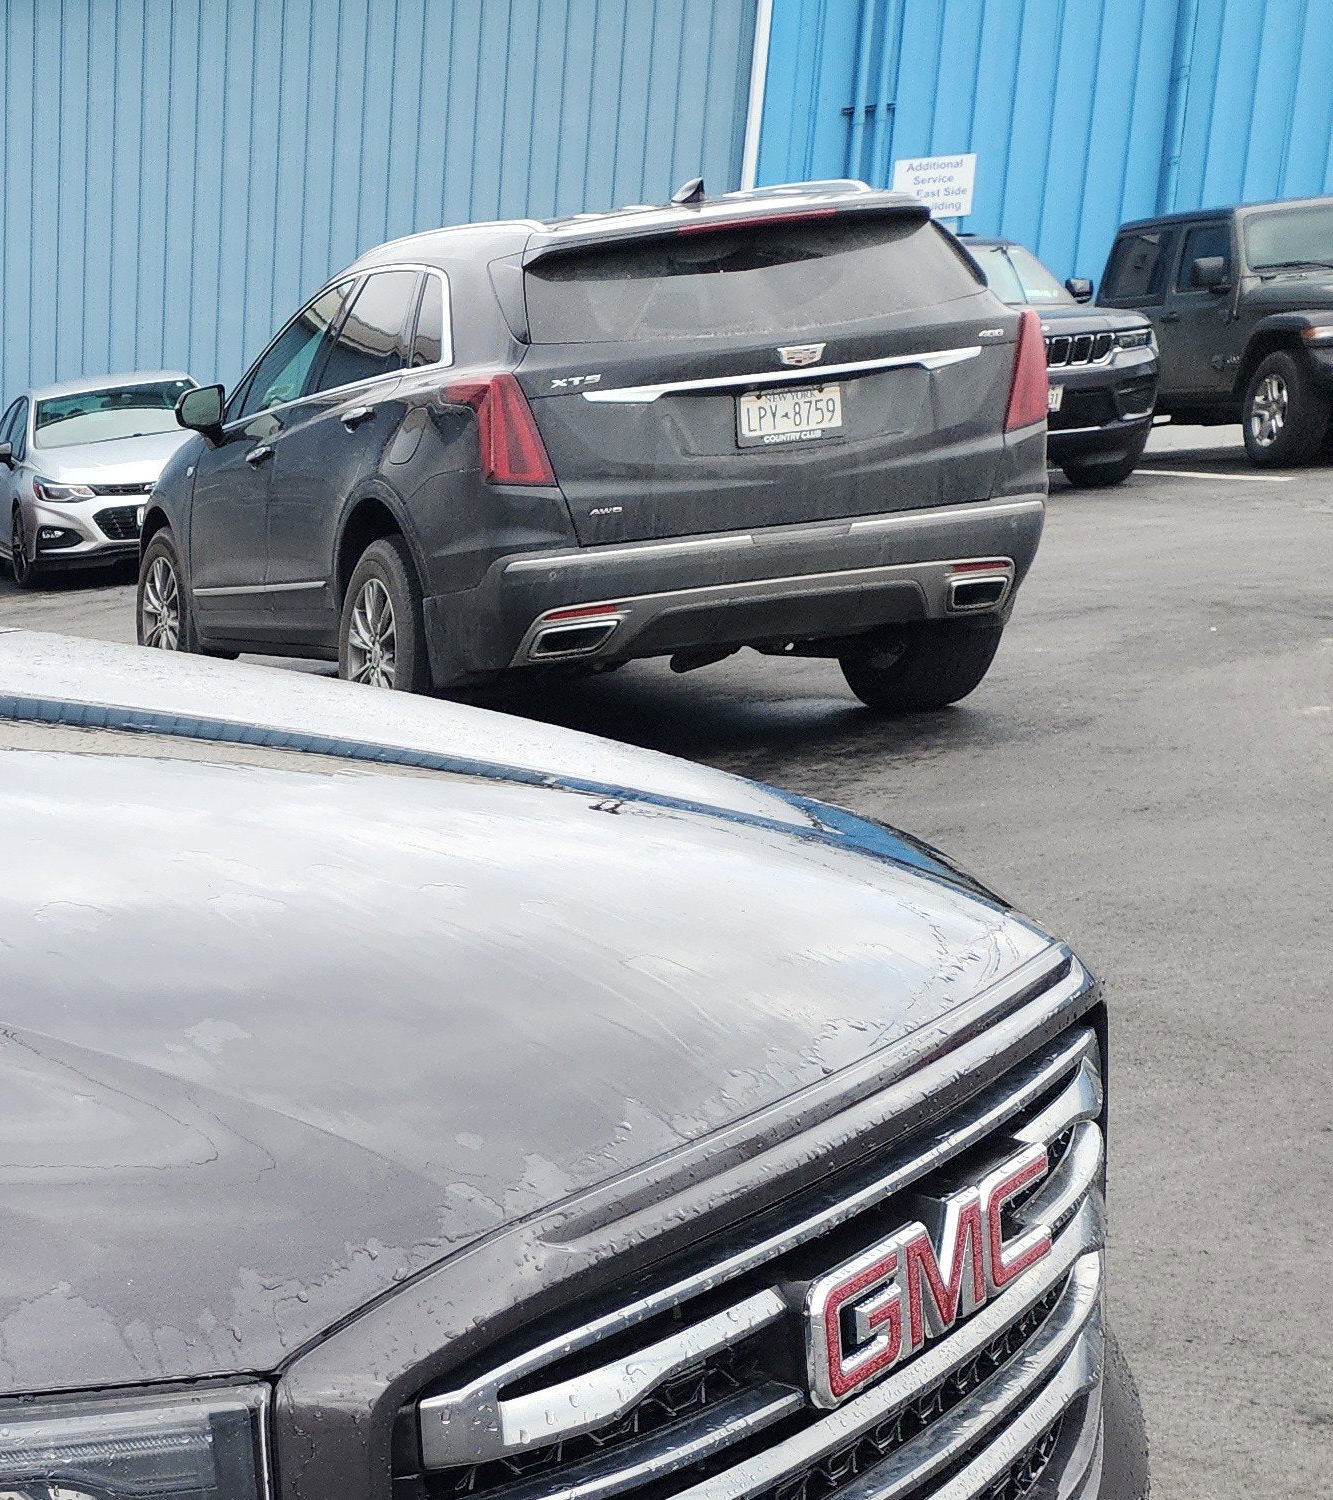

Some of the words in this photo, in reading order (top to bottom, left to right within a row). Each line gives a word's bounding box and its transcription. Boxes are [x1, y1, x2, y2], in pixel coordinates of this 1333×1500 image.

[907, 160, 963, 172] Additional
[913, 175, 954, 185] Service
[944, 186, 967, 196] Side
[550, 373, 602, 389] XT5
[764, 433, 800, 443] COUNTRY
[801, 429, 822, 440] CLUB
[805, 1141, 1053, 1410] GMC
